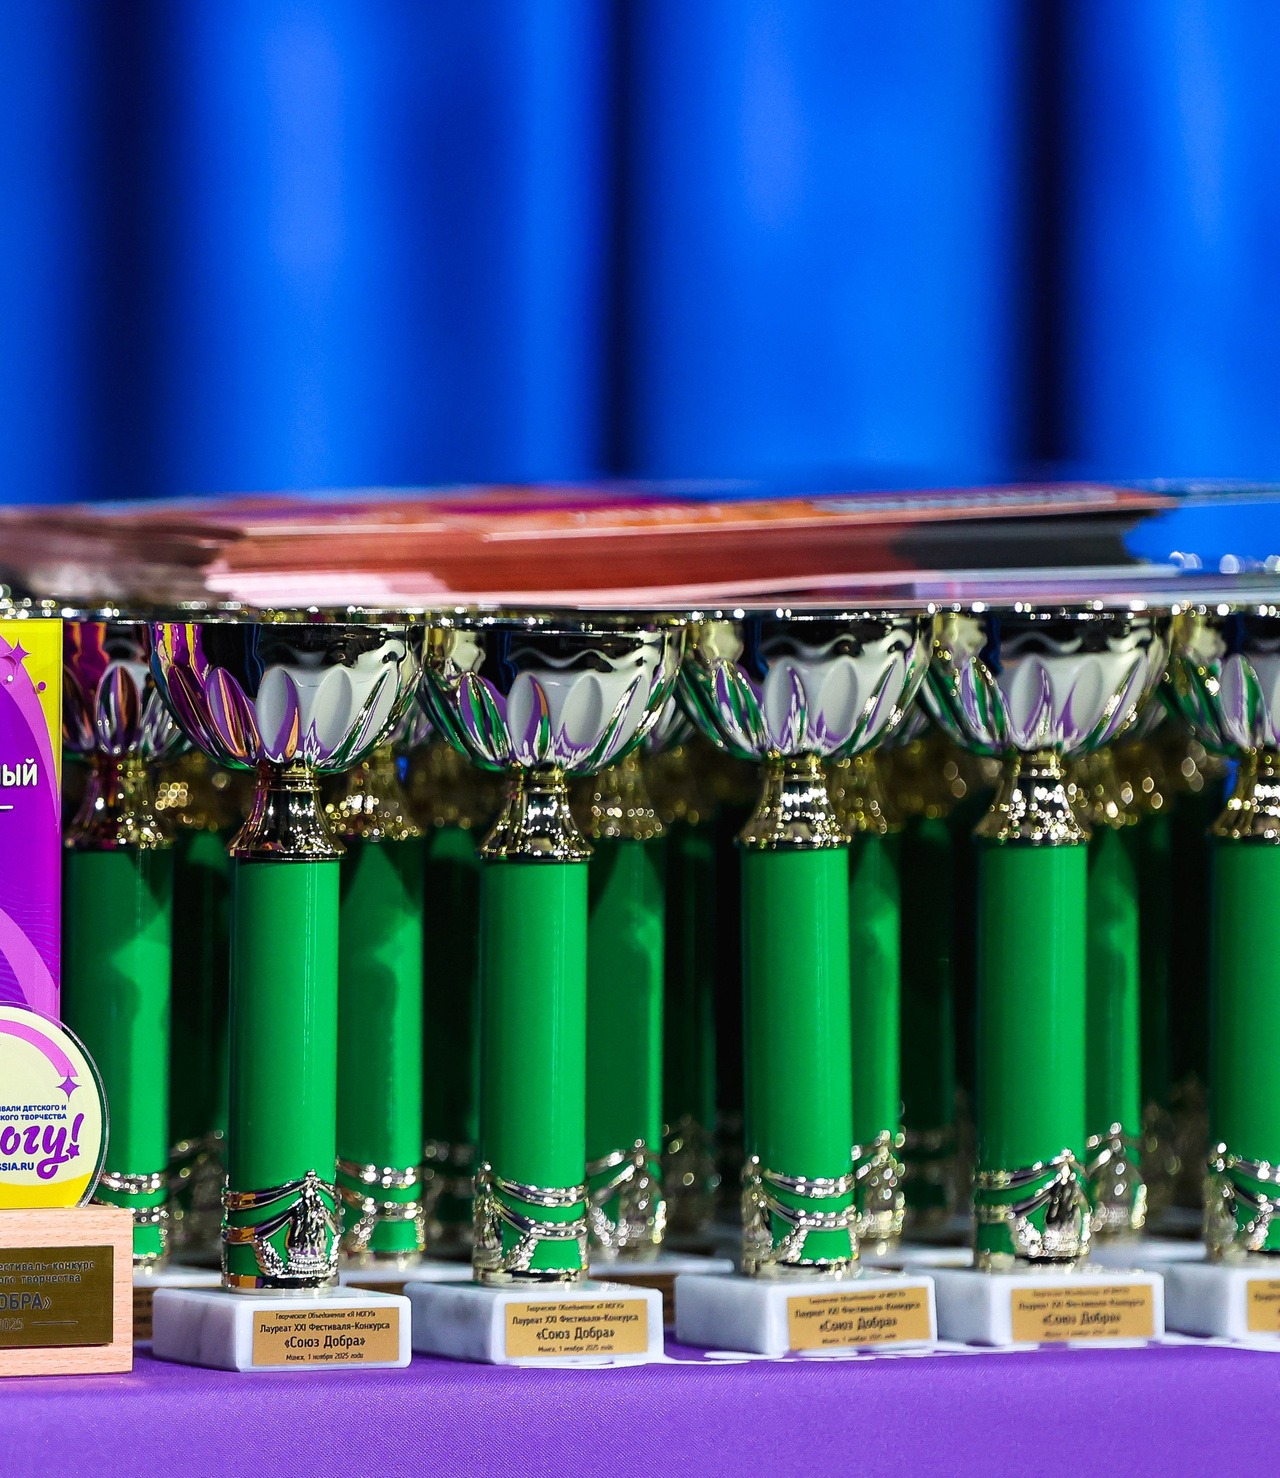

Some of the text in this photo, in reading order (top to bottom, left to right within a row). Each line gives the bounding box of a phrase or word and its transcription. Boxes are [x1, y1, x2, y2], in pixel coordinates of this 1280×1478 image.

[22, 1105, 59, 1113] ДЕТСКОГО
[21, 1113, 67, 1121] ТВОРЧЕСТВА
[21, 1274, 81, 1286] творчества
[260, 1322, 390, 1334] Лауреат XXI Фестиваля-Конкурса
[536, 1327, 615, 1341] «Союз Добра»
[284, 1334, 365, 1349] «Союз Добра»
[312, 1352, 333, 1360] ноября
